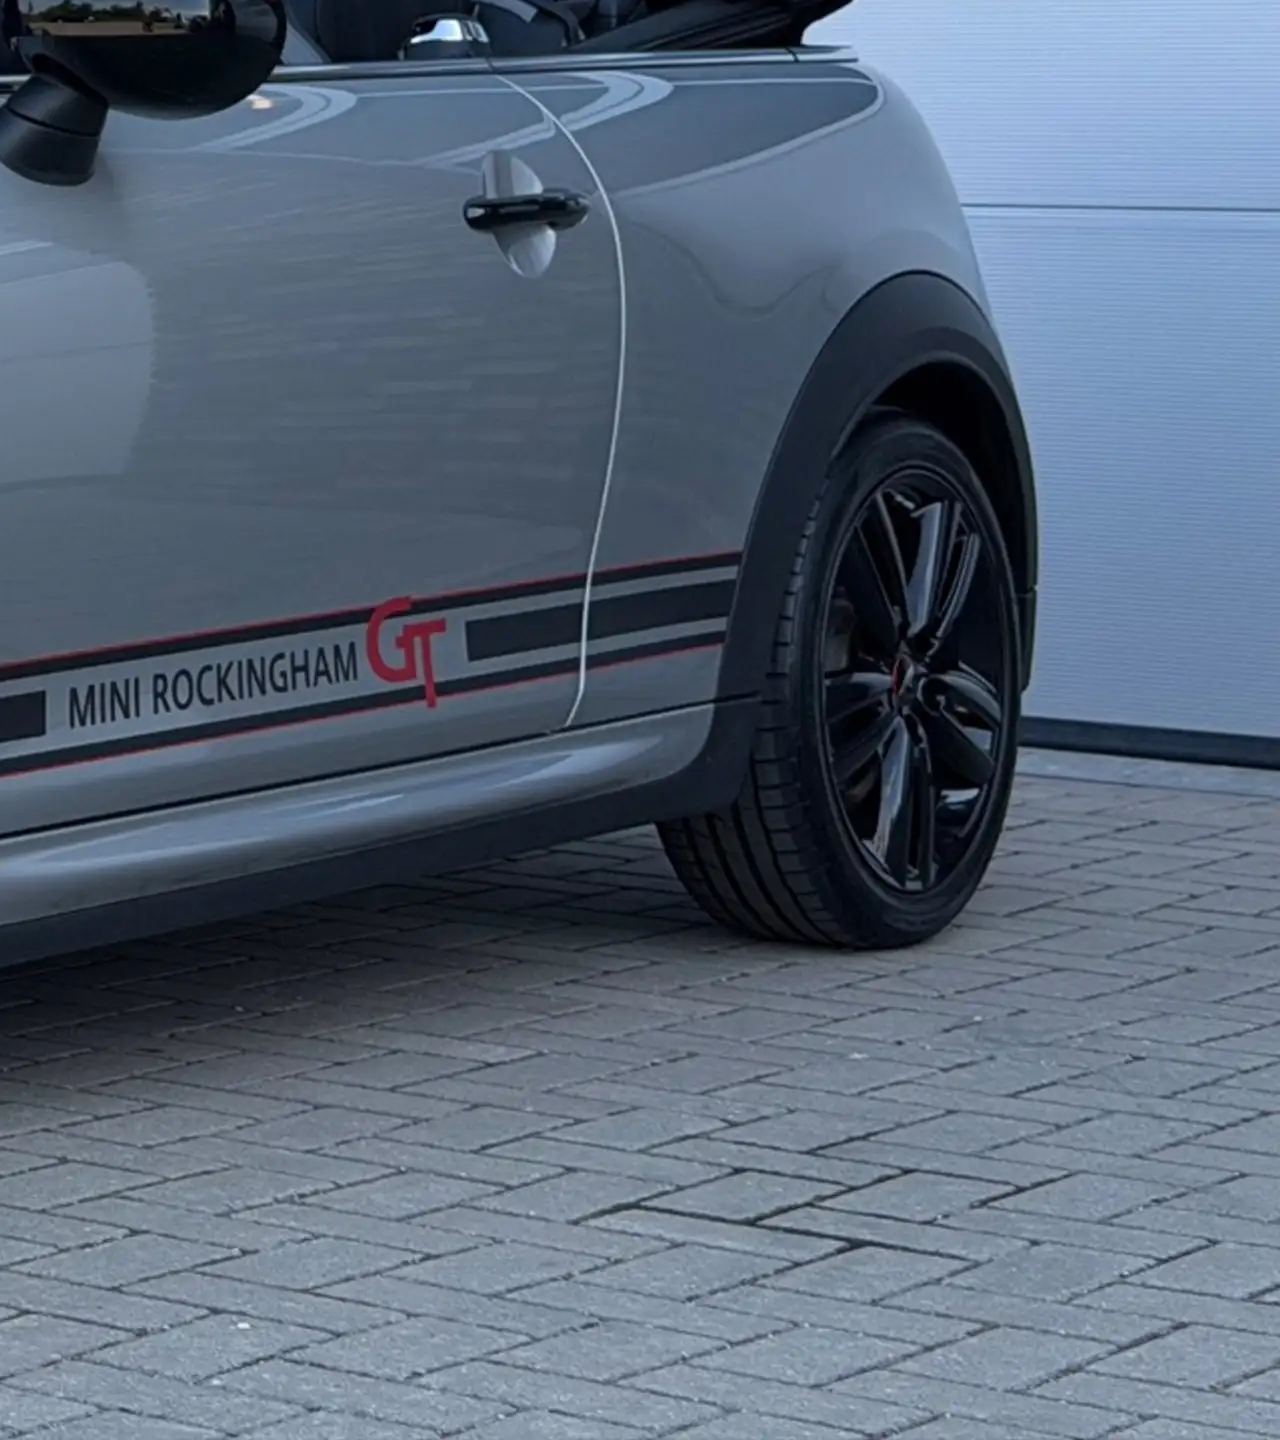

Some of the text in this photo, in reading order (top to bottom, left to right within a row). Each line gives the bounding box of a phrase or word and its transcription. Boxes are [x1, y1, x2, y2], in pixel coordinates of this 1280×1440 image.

[69, 596, 447, 730] MINI ROCKINGHAM GT
